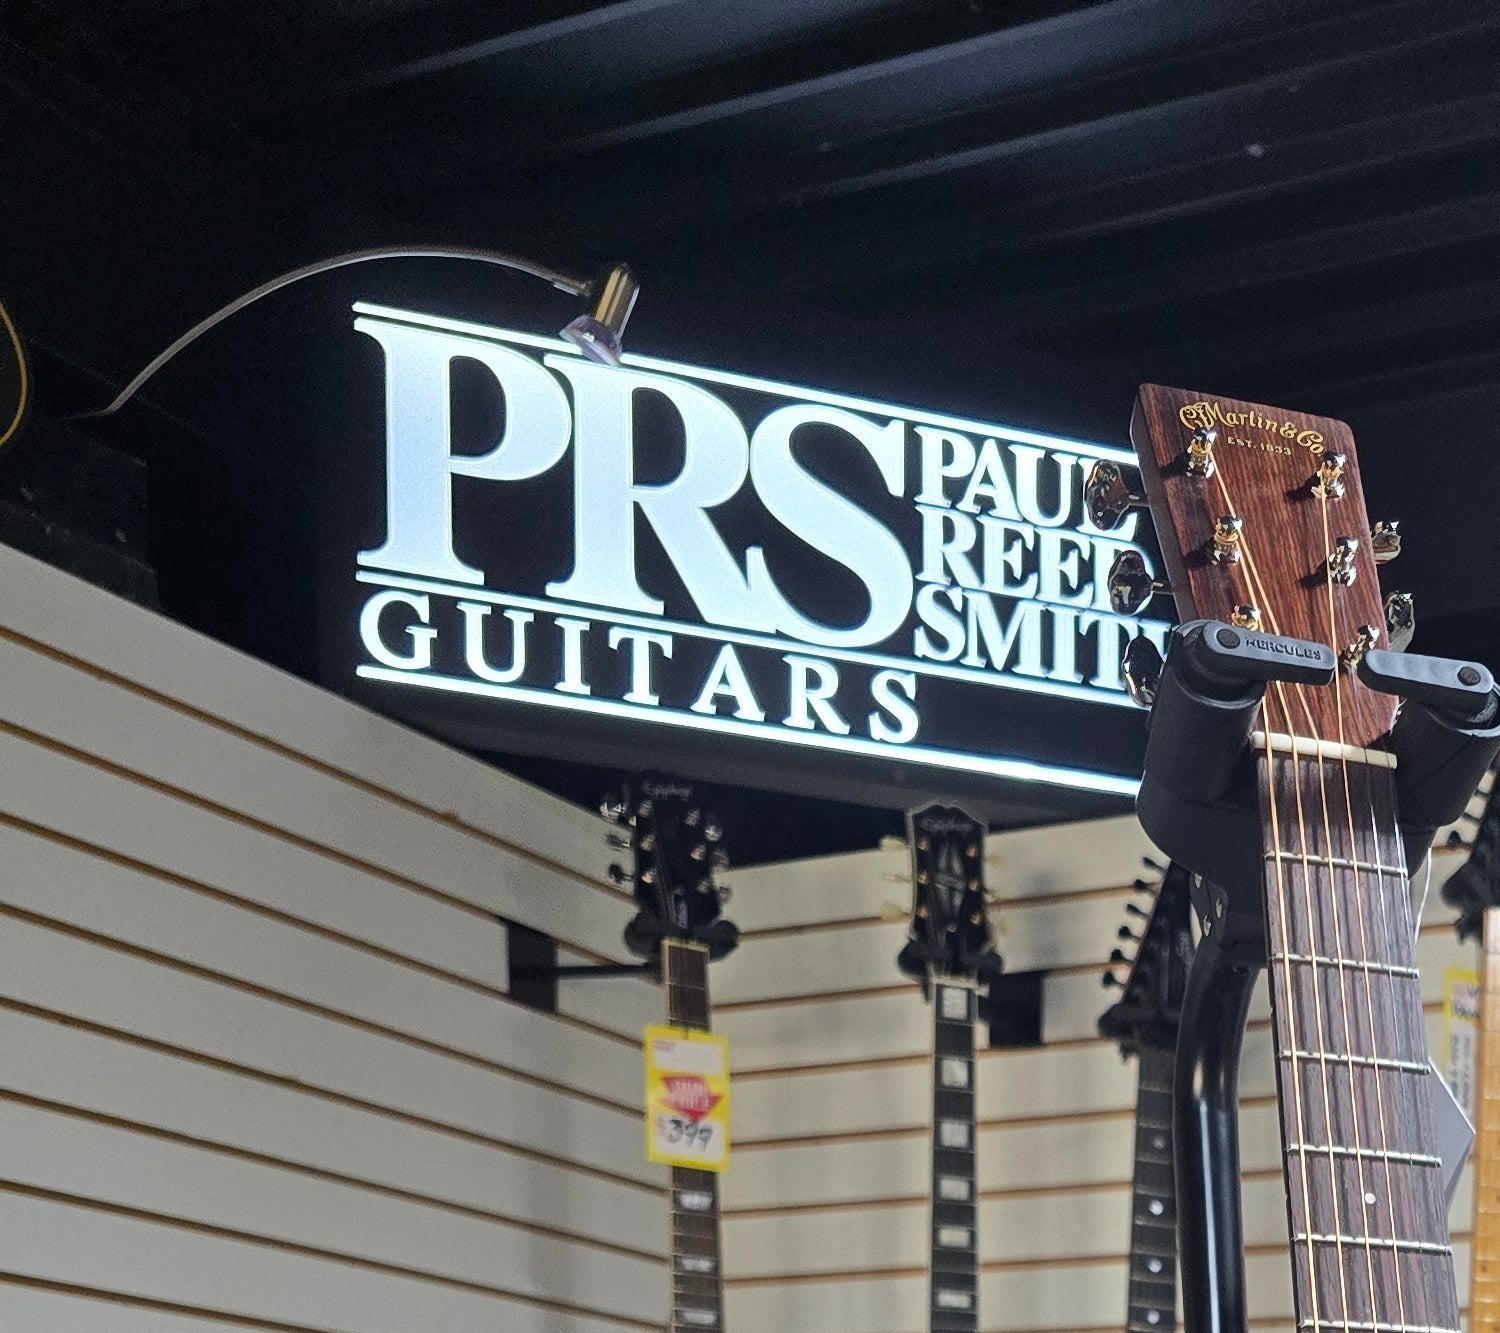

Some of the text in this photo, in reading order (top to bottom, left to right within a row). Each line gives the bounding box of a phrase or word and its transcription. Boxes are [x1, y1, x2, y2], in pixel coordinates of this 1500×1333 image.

[354, 317, 913, 648] PRS
[914, 425, 1138, 541] PAUL
[915, 505, 1154, 616] REED
[356, 589, 920, 745] GUITARS
[1245, 637, 1322, 661] HERCULES
